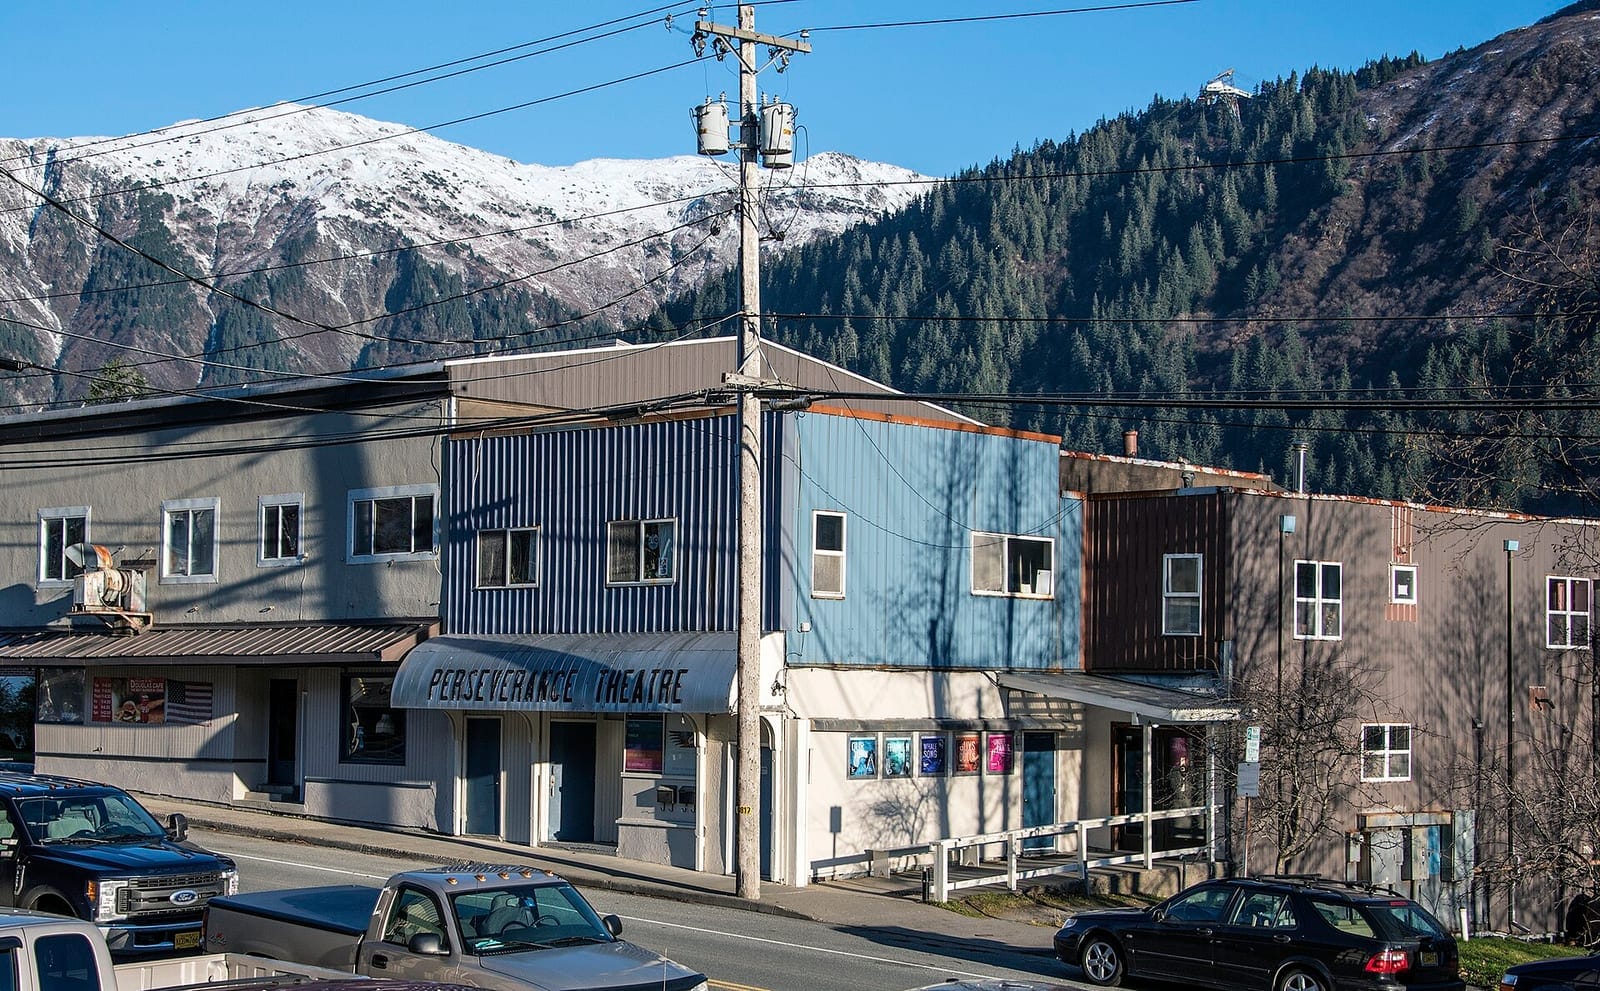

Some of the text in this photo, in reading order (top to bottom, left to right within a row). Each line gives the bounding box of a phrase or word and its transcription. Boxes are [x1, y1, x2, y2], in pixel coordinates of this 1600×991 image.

[130, 679, 152, 689] DOUGLAS
[428, 669, 688, 703] PERSEVERANCE THEATRE
[177, 893, 192, 901] Ford
